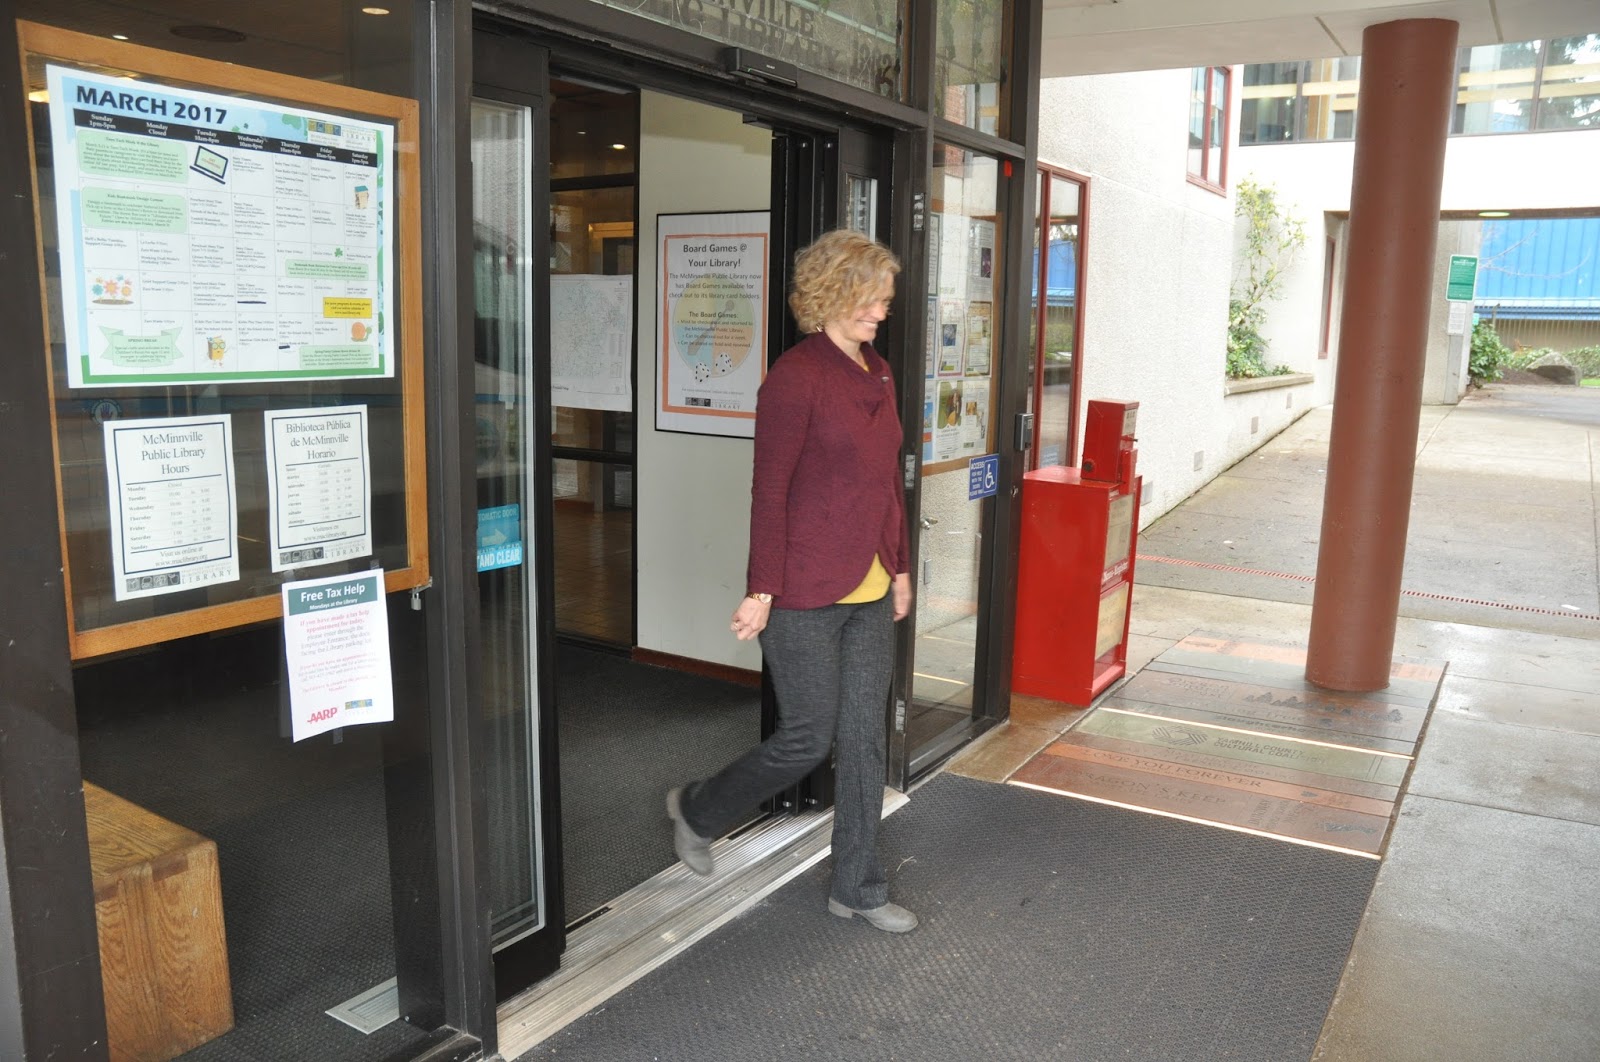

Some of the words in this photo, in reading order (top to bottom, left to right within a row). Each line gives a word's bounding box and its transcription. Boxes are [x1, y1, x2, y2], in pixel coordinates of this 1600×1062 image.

[75, 84, 167, 116] MARCH
[173, 101, 227, 125] 2017
[91, 114, 113, 123] Sunday
[146, 122, 168, 130] Monday
[148, 128, 166, 136] Closed
[196, 129, 217, 137] Tuesday
[237, 135, 263, 144] Wednesday
[280, 141, 300, 150] Thursday
[683, 244, 706, 252] Board
[709, 244, 737, 252] Games
[740, 243, 747, 251] @
[709, 259, 740, 268] Library!
[709, 292, 724, 300] library
[286, 421, 324, 433] Biblioteca
[326, 419, 350, 430] Pública
[143, 431, 203, 445] McMinnville
[290, 438, 300, 447] de
[302, 433, 348, 446] McMinnville
[142, 448, 170, 460] Public
[173, 446, 205, 460] Library
[307, 448, 335, 459] Horario
[161, 462, 189, 474] Hours
[970, 461, 984, 470] ACCESS
[325, 546, 365, 558] LIBRARY
[496, 549, 520, 565] CLEAR
[182, 569, 231, 584] LIBRARY
[300, 589, 323, 602] Free
[325, 586, 341, 598] Tax
[343, 582, 365, 597] Help
[309, 602, 329, 610] Mondays
[343, 597, 357, 605] Library
[306, 622, 339, 633] appointment
[306, 706, 338, 724] AARP
[1212, 741, 1266, 754] CULTURAL
[1216, 737, 1261, 748] YAMHILL
[1262, 744, 1305, 755] COUNTY
[1079, 748, 1131, 763] LOVE
[1131, 758, 1171, 770] YOU
[1174, 766, 1263, 788] FOREVER
[1176, 790, 1226, 805] KEEP
